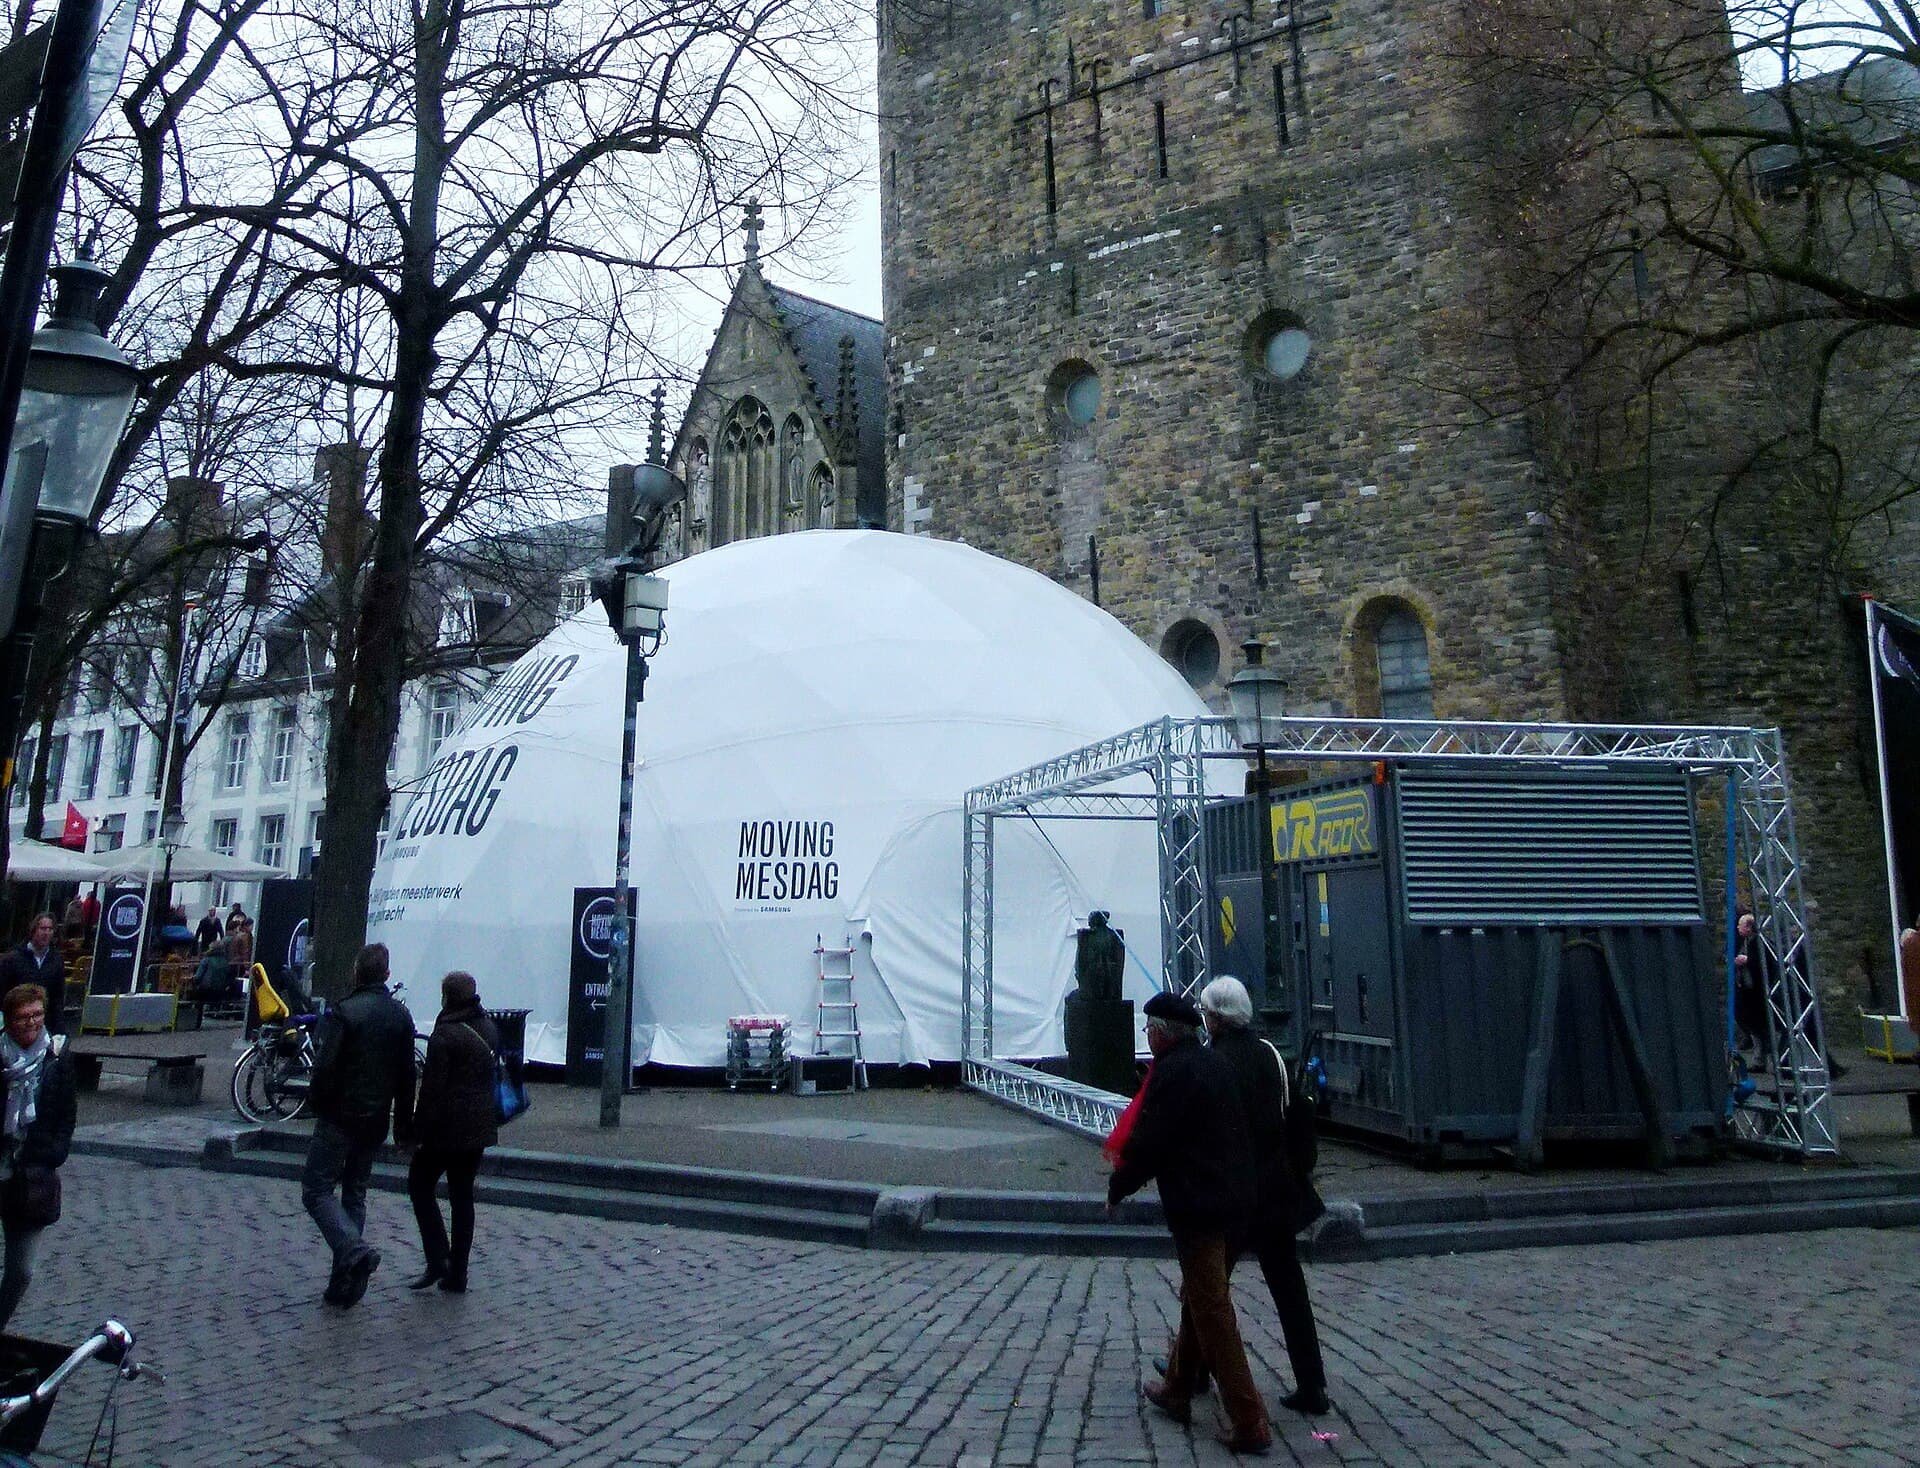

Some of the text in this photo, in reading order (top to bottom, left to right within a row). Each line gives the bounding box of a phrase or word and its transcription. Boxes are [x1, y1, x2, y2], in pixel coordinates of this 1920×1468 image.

[738, 821, 834, 857] MOVING
[401, 884, 462, 899] meesterwerk
[736, 862, 839, 899] MESDAG
